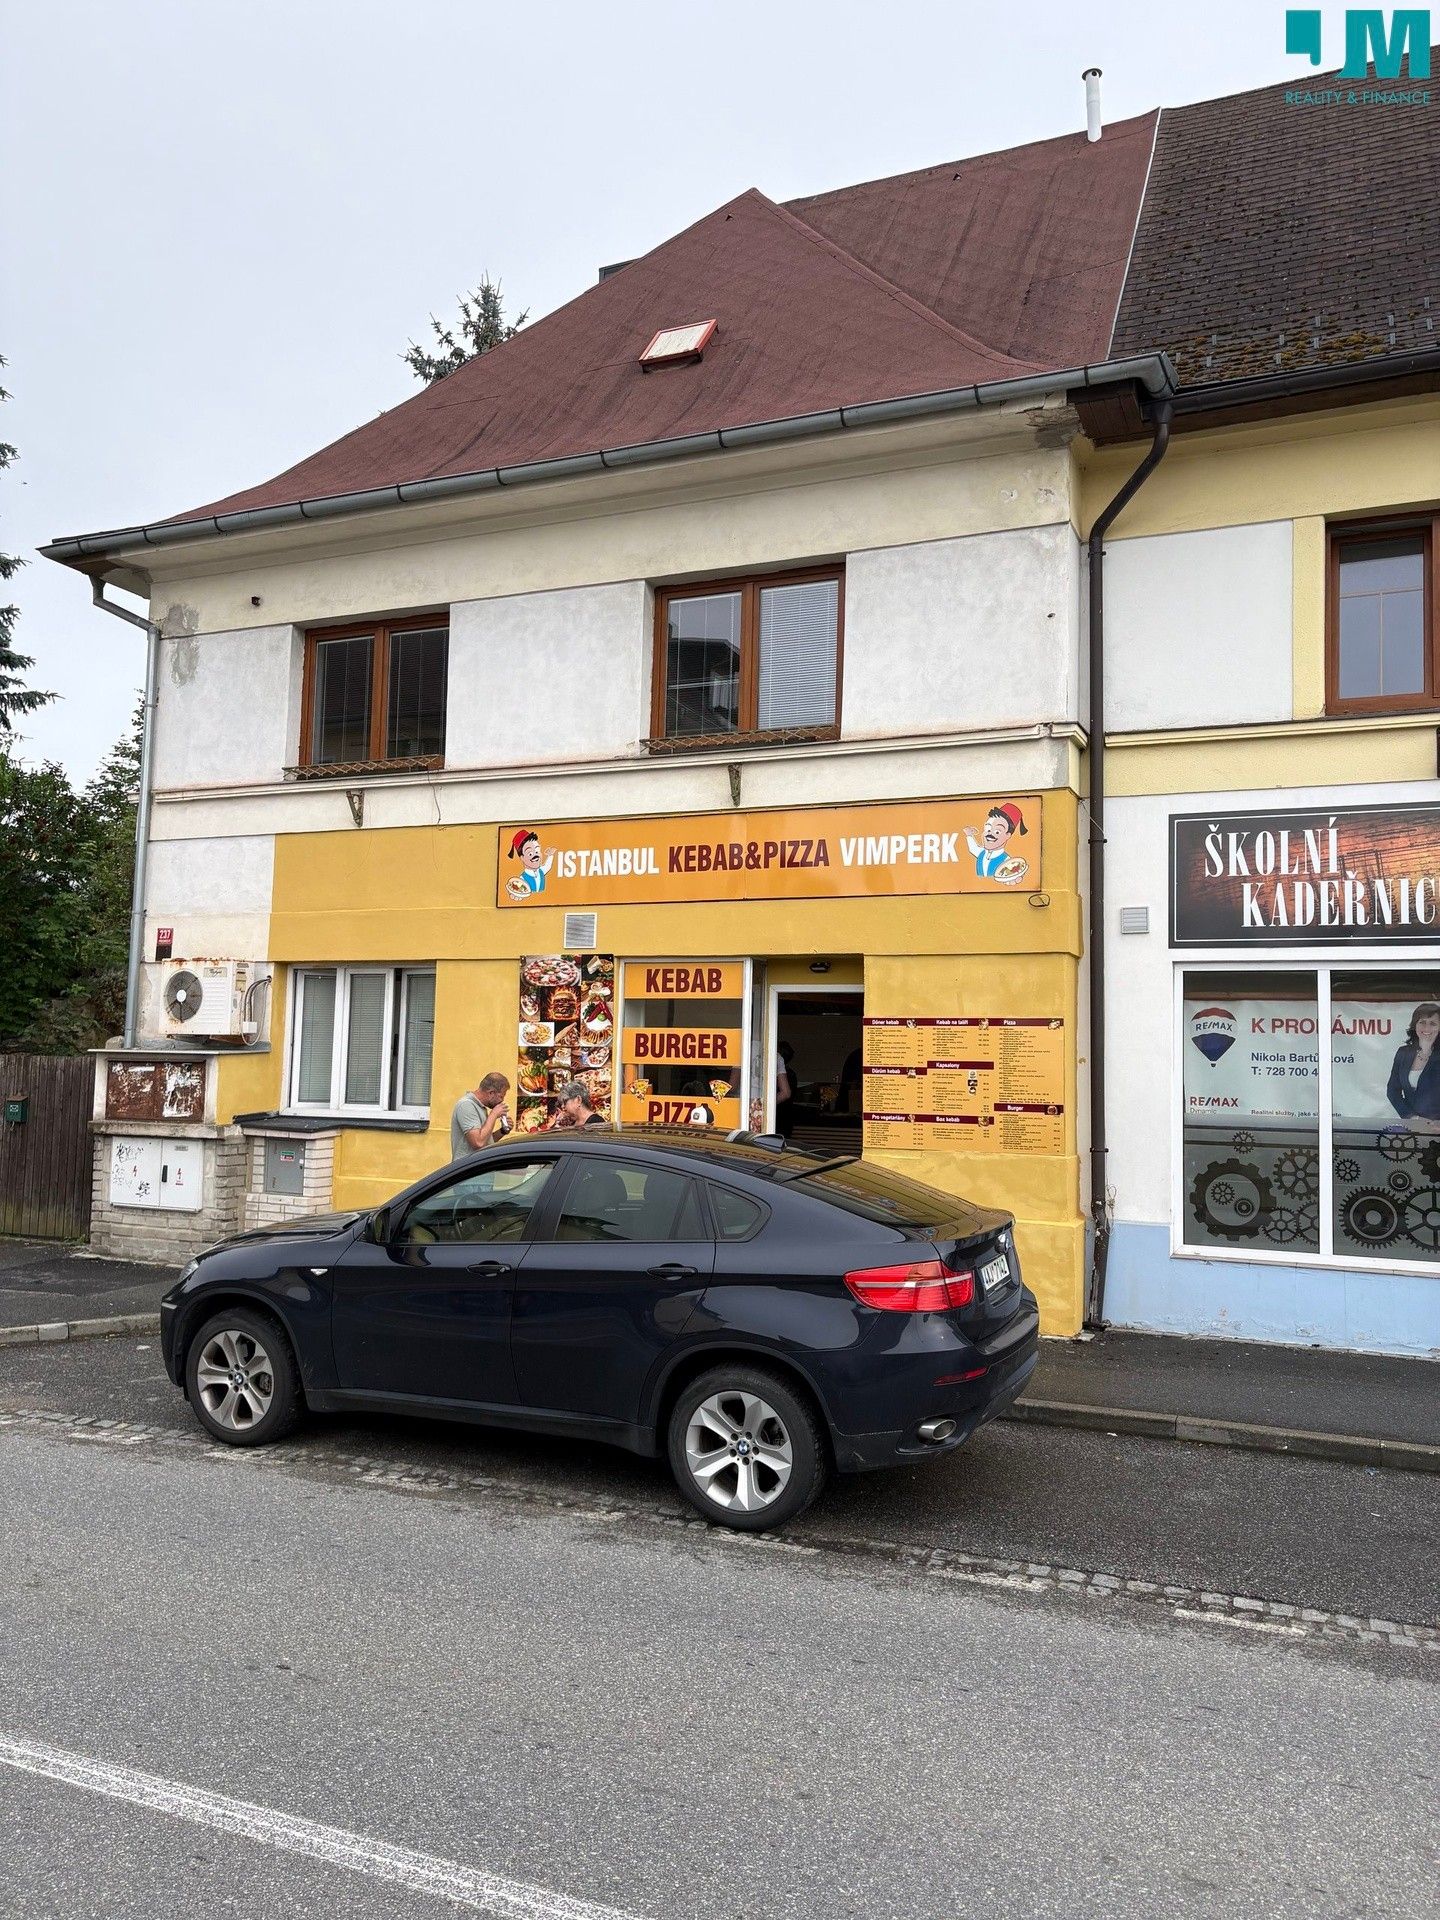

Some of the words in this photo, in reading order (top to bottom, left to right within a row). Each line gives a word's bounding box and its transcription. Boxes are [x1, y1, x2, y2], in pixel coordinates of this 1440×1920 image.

[556, 847, 660, 878] ISTANBUL
[668, 838, 830, 873] KEBAB&PIZZA
[839, 832, 960, 867] VIMPERK
[1204, 816, 1340, 878] ŠKOLNÍ
[1241, 871, 1440, 928] KADEŘNIC
[159, 929, 171, 939] 237
[645, 968, 723, 993] KEBAB
[1195, 1021, 1233, 1032] RE/MAX
[1251, 1018, 1265, 1034] K
[1272, 1015, 1392, 1035] PROÁJMU
[634, 1033, 728, 1059] BURGER
[1251, 1052, 1286, 1062] Nikola
[1289, 1052, 1355, 1064] Bartůová
[1251, 1067, 1261, 1076] T:
[1266, 1067, 1286, 1076] 728
[1289, 1067, 1308, 1077] 700
[1190, 1096, 1239, 1107] RE/MAX
[648, 1101, 709, 1124] PIZZ
